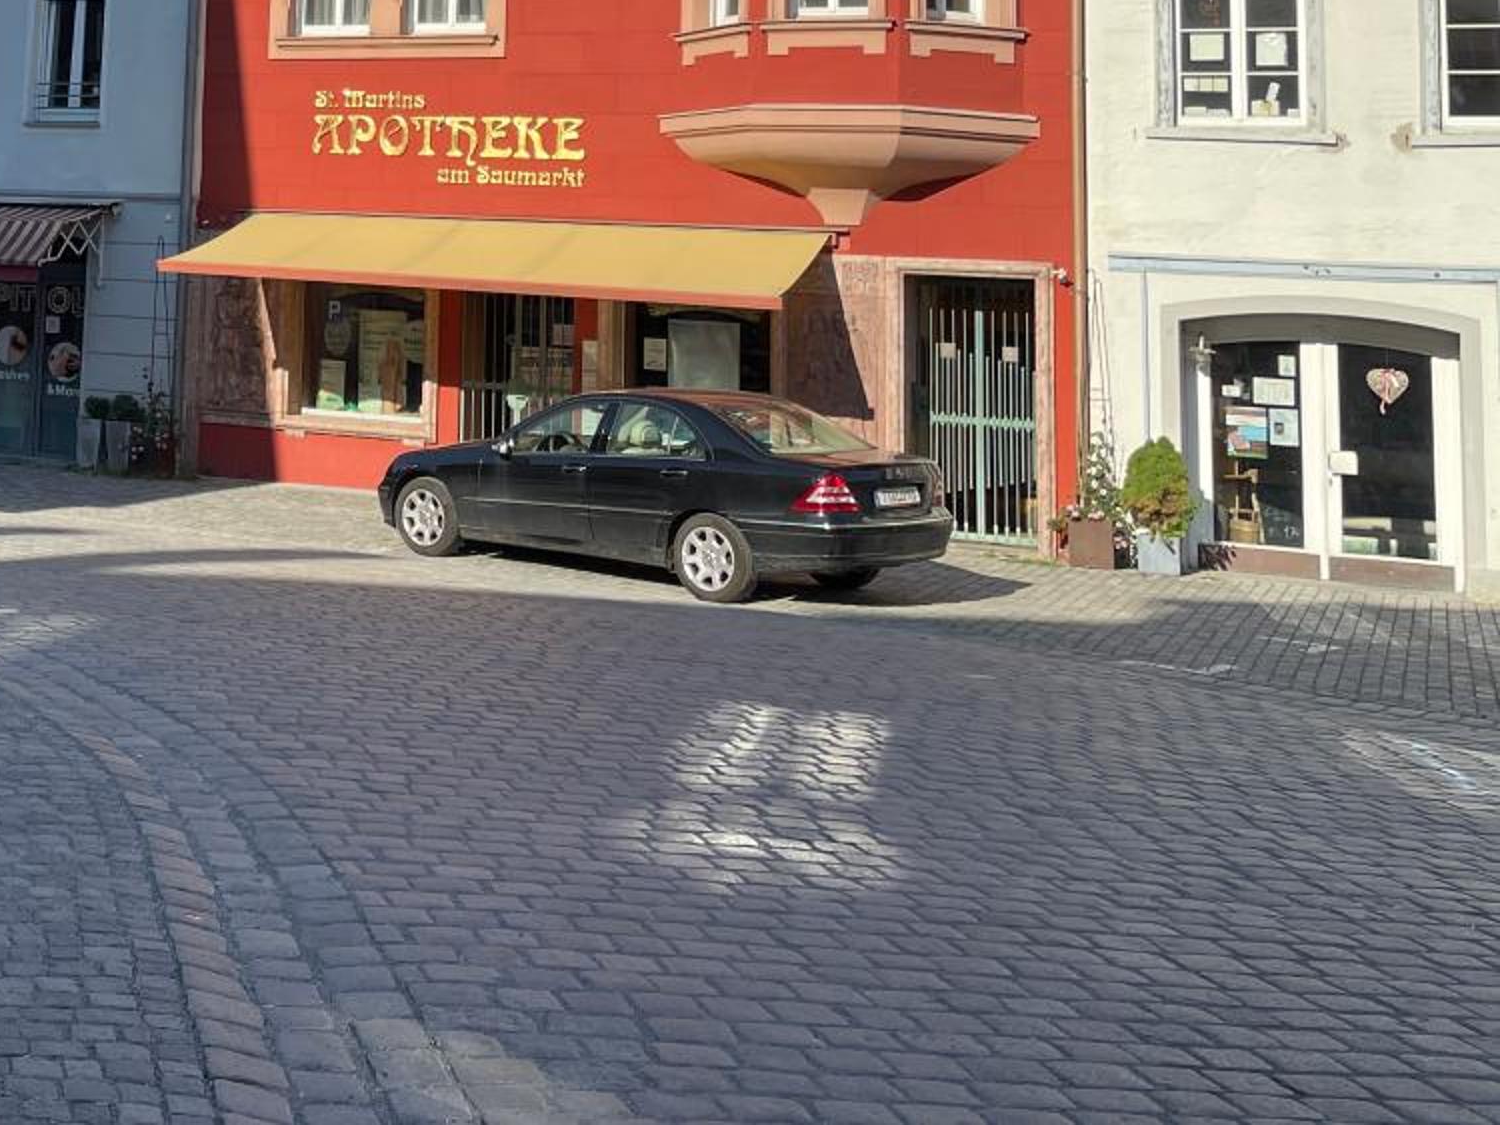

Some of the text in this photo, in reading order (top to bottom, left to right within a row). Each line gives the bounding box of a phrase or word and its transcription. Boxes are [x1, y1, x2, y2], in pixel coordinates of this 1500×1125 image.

[343, 88, 426, 109] Martins
[311, 115, 586, 167] APOTHEKE
[437, 165, 586, 188] am Saumarkt
